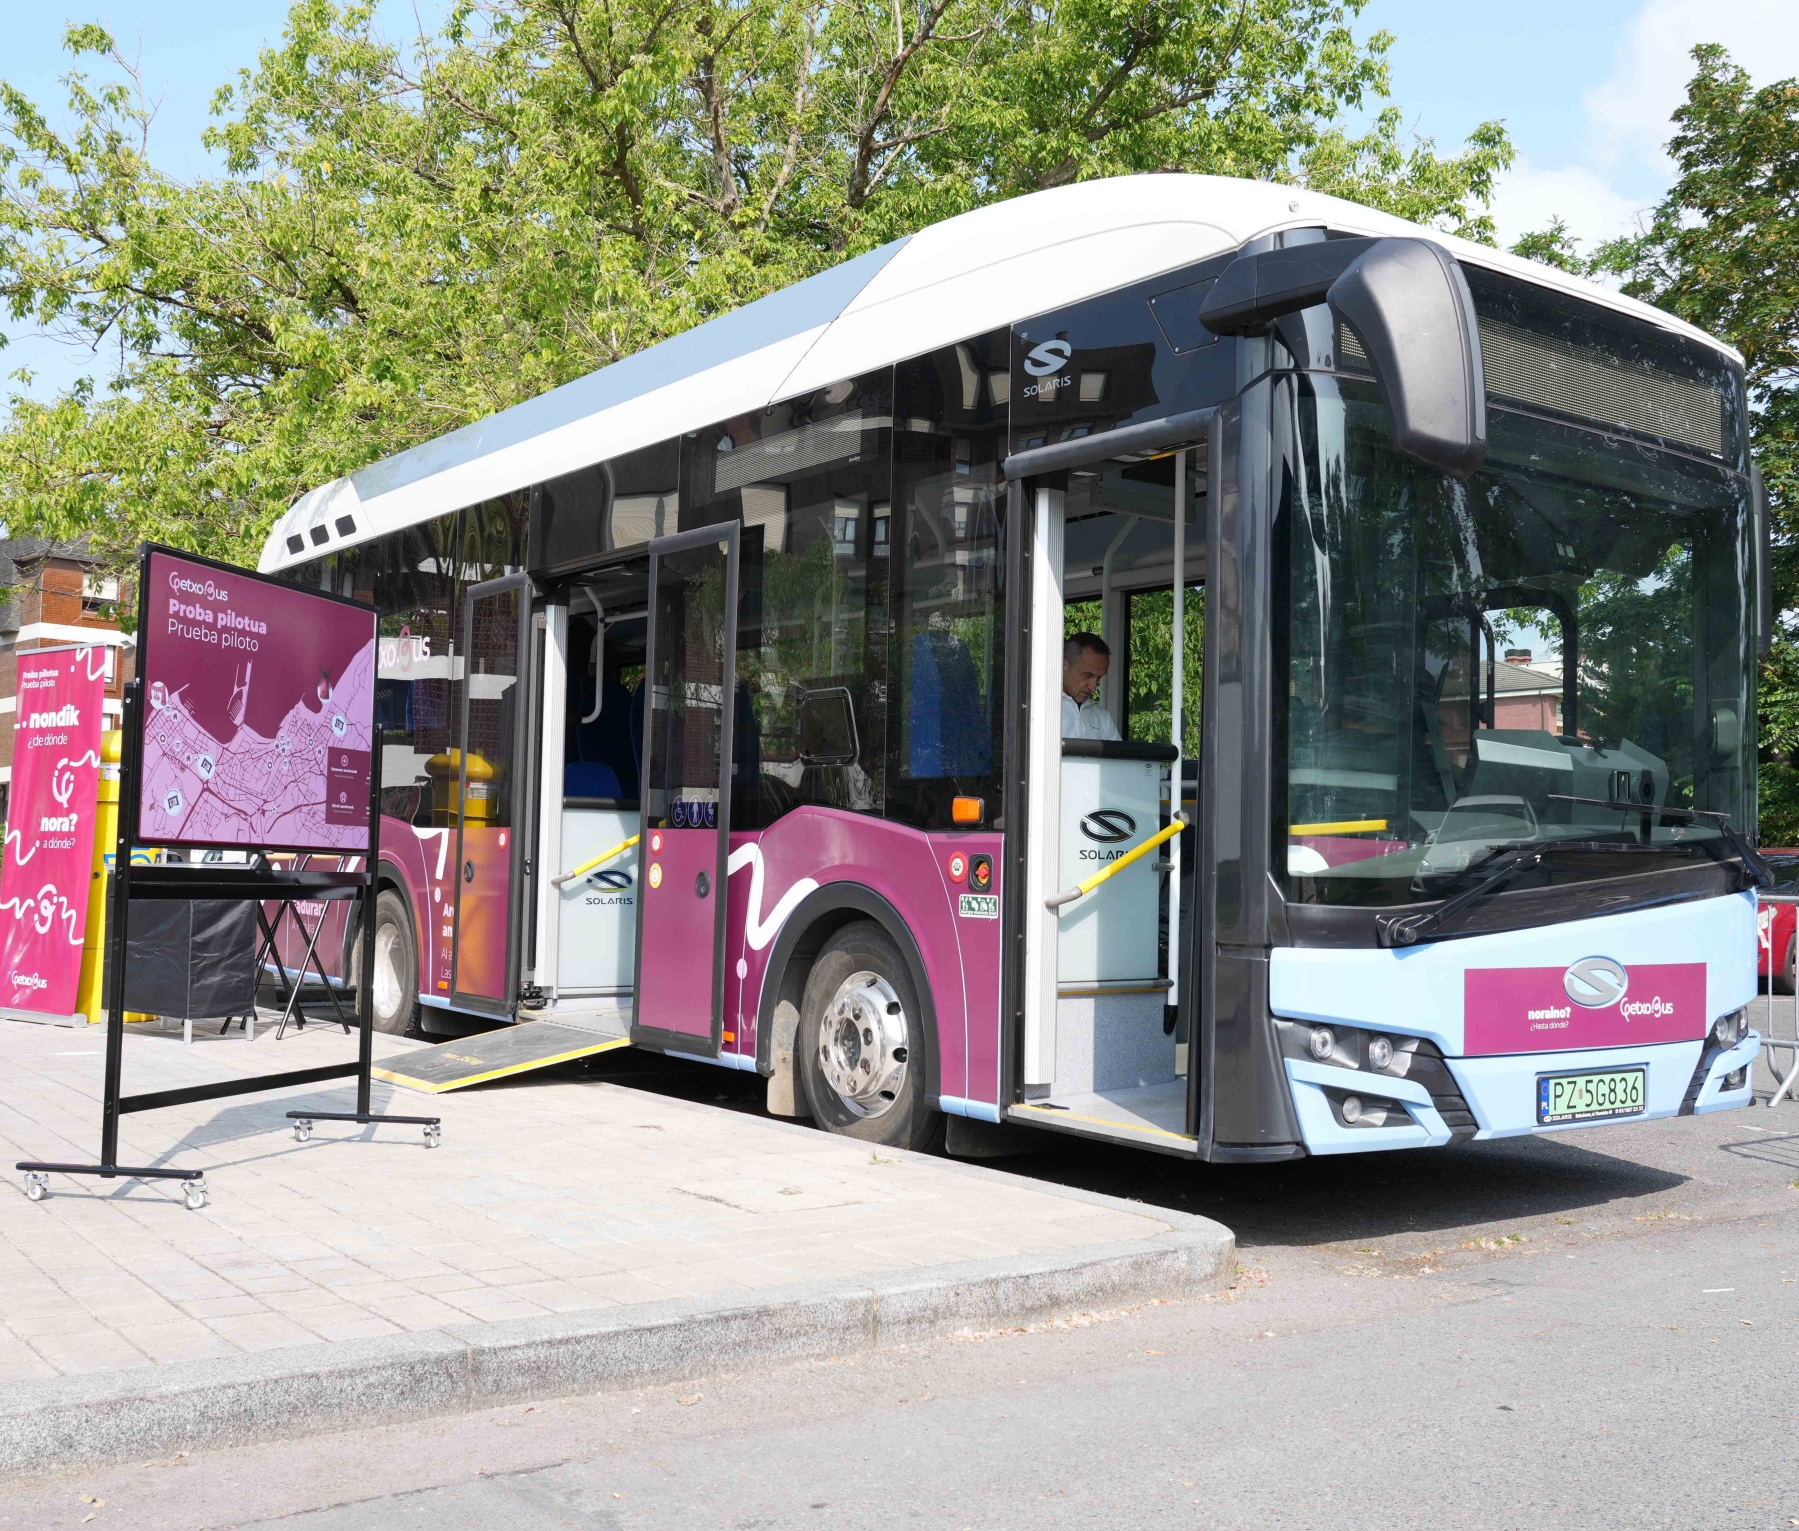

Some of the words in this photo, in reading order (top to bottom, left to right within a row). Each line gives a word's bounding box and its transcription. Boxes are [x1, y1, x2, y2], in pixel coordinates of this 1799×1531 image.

[1023, 375, 1071, 398] SOLARIS
[169, 598, 214, 623] Proba
[217, 609, 267, 634] pilotua
[168, 618, 218, 643] Prueba
[221, 630, 259, 651] piloto
[22, 670, 38, 679] Proba
[39, 668, 59, 679] pilotua
[22, 680, 39, 689] Prueba
[40, 679, 56, 689] piloto
[29, 704, 80, 728] nondik
[28, 734, 43, 749] ¿de
[44, 733, 68, 745] dónde
[40, 813, 78, 832] nora?
[48, 838, 76, 849] dónde?
[1079, 849, 1129, 860] SOLAR
[585, 897, 633, 905] SOLARIS
[1528, 1005, 1571, 1020] noraino?
[1530, 1022, 1548, 1031] ¿Hasta
[1549, 1020, 1569, 1029] dónde?
[1554, 1081, 1577, 1111] PZ
[1585, 1076, 1638, 1107] 5G836
[1541, 1102, 1549, 1110] PL
